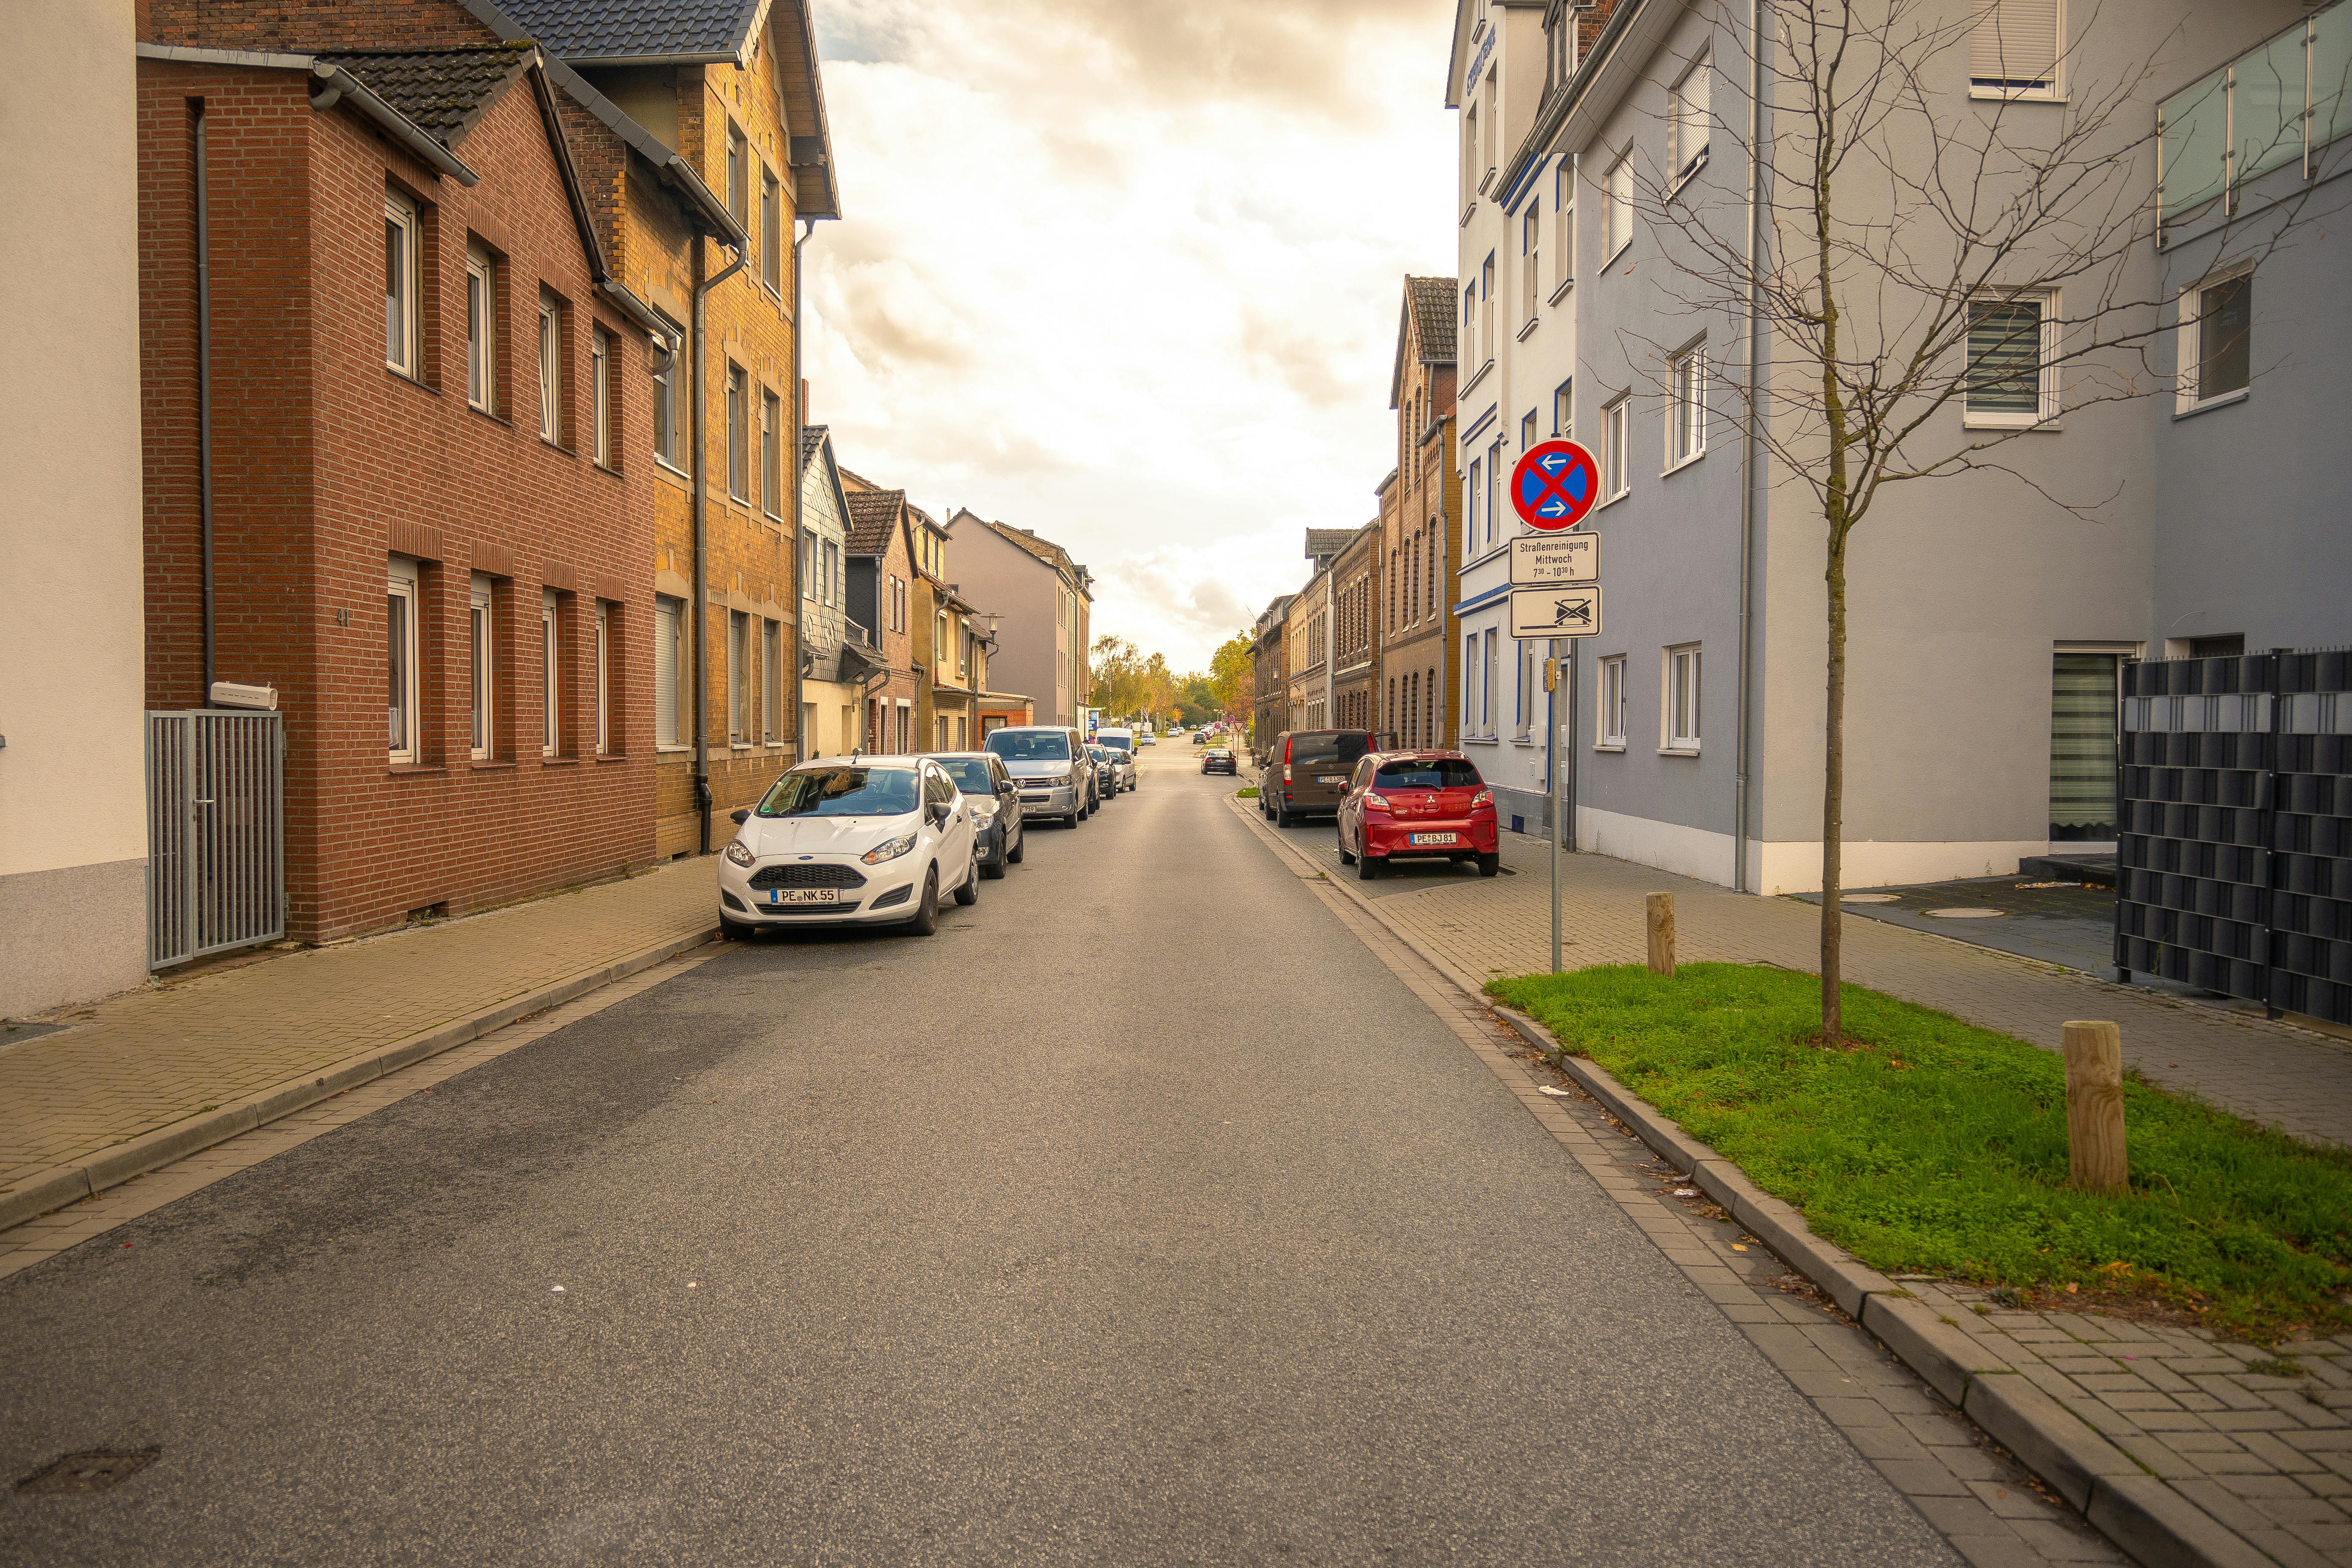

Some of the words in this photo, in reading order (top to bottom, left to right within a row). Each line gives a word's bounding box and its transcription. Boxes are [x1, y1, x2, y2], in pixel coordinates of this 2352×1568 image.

[1520, 540, 1588, 553] Straßenreinigung
[1536, 553, 1572, 564] Mittwoch
[1570, 566, 1574, 576] h
[781, 891, 796, 901] PE
[803, 890, 818, 901] NK
[820, 890, 834, 900] 55
